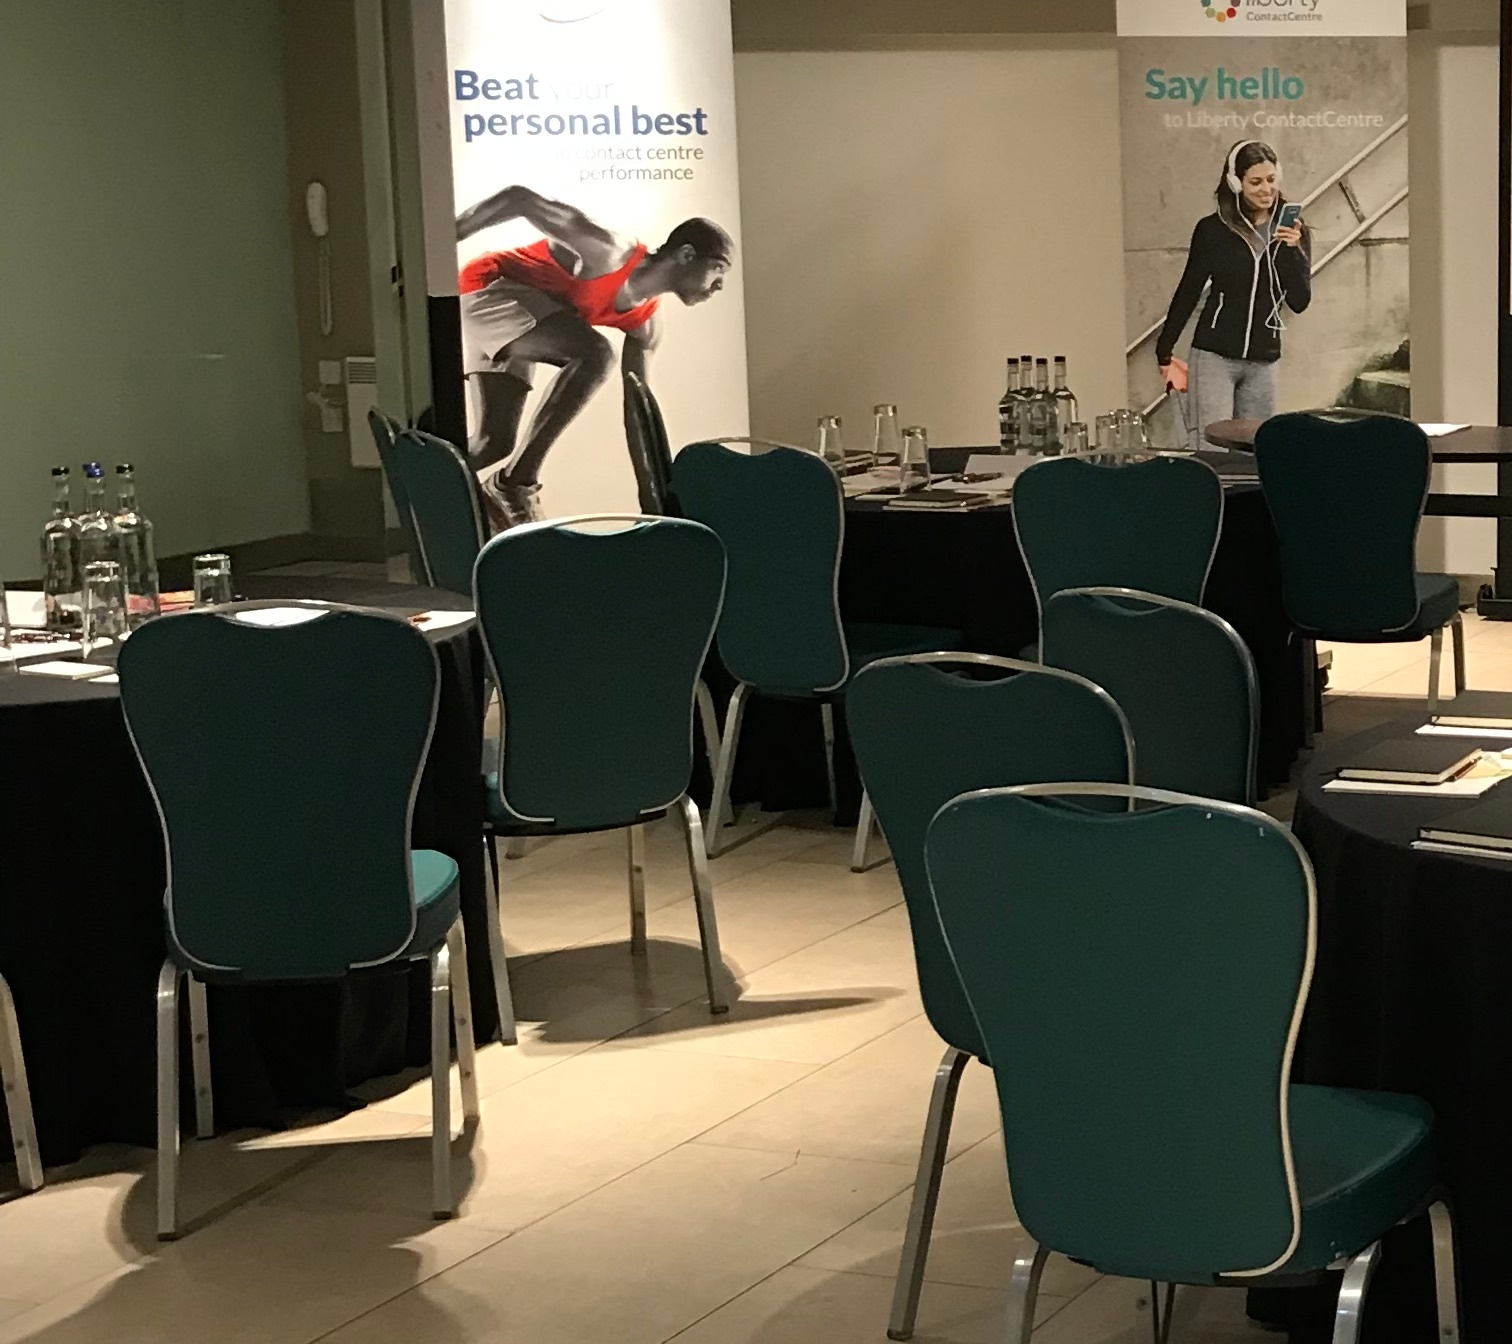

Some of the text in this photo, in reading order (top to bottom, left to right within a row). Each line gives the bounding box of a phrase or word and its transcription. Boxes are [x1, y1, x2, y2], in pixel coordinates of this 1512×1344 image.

[1246, 12, 1323, 22] ContactCentre
[454, 69, 540, 101] Beat
[1145, 67, 1305, 106] Say hello
[464, 105, 709, 143] personal best
[1163, 110, 1384, 130] to Liberty ContactCentre
[646, 146, 705, 160] centre
[579, 166, 694, 182] performance
